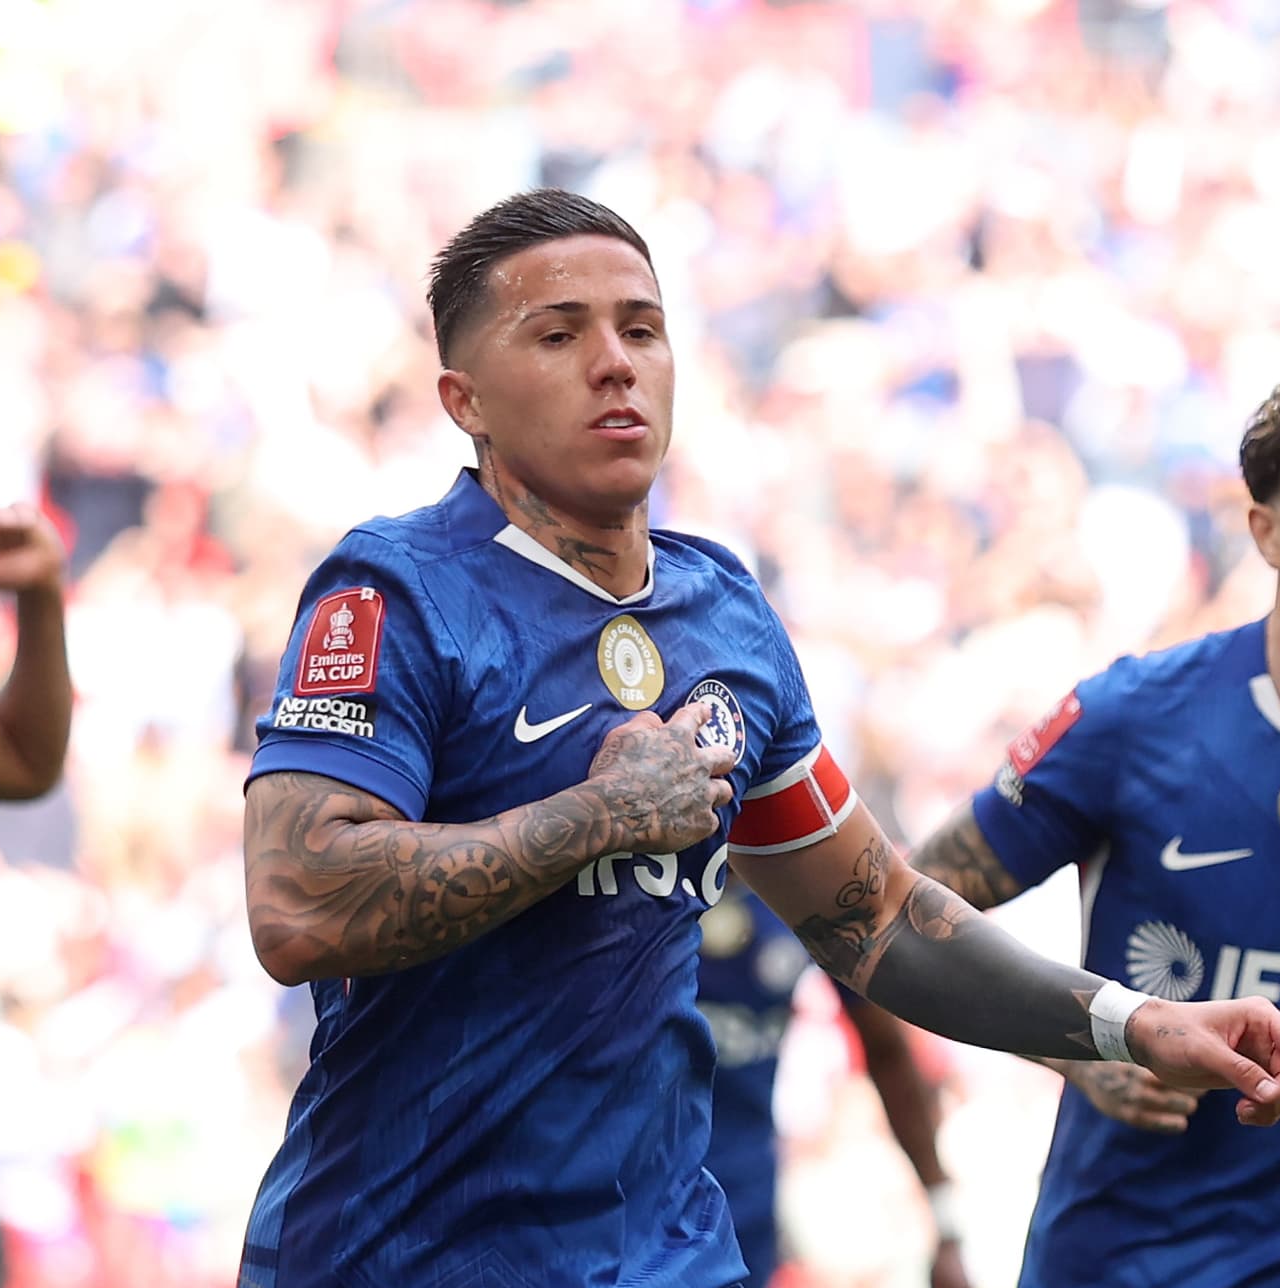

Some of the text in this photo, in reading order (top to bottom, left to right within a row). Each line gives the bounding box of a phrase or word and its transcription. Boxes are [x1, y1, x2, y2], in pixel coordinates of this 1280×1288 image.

[309, 653, 365, 667] Emirates
[604, 624, 657, 675] WORLD CHAMPIONS
[307, 666, 364, 682] FA CUP
[620, 688, 646, 701] FIFA
[693, 683, 730, 704] CHELSEA
[277, 697, 367, 720] No room
[303, 712, 374, 738] racism
